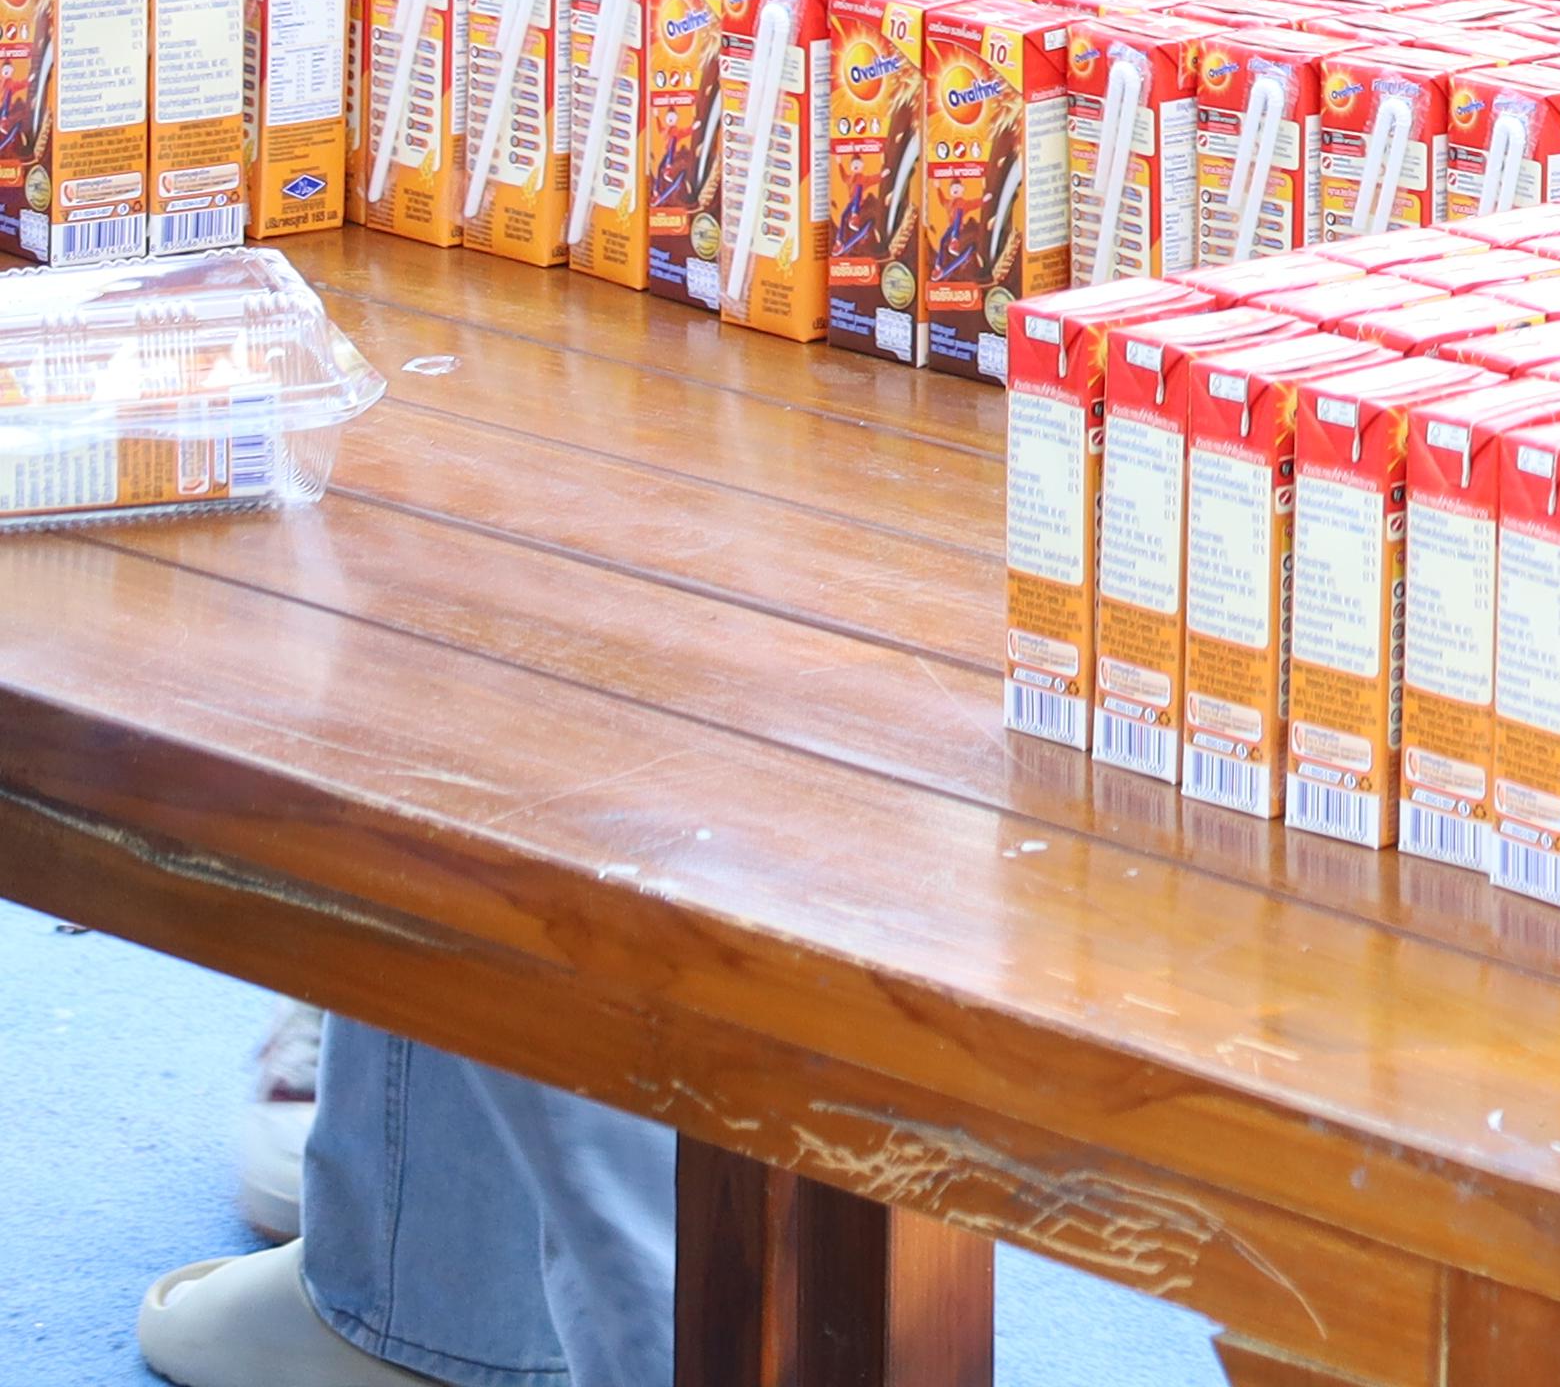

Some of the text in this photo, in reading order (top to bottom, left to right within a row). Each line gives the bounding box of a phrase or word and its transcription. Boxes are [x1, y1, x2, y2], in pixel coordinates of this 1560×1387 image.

[667, 10, 712, 38] Ovaltine
[889, 18, 907, 40] 10
[988, 41, 1007, 65] 10
[850, 56, 901, 84] Ovaltine
[948, 80, 1001, 107] Ovaltine
